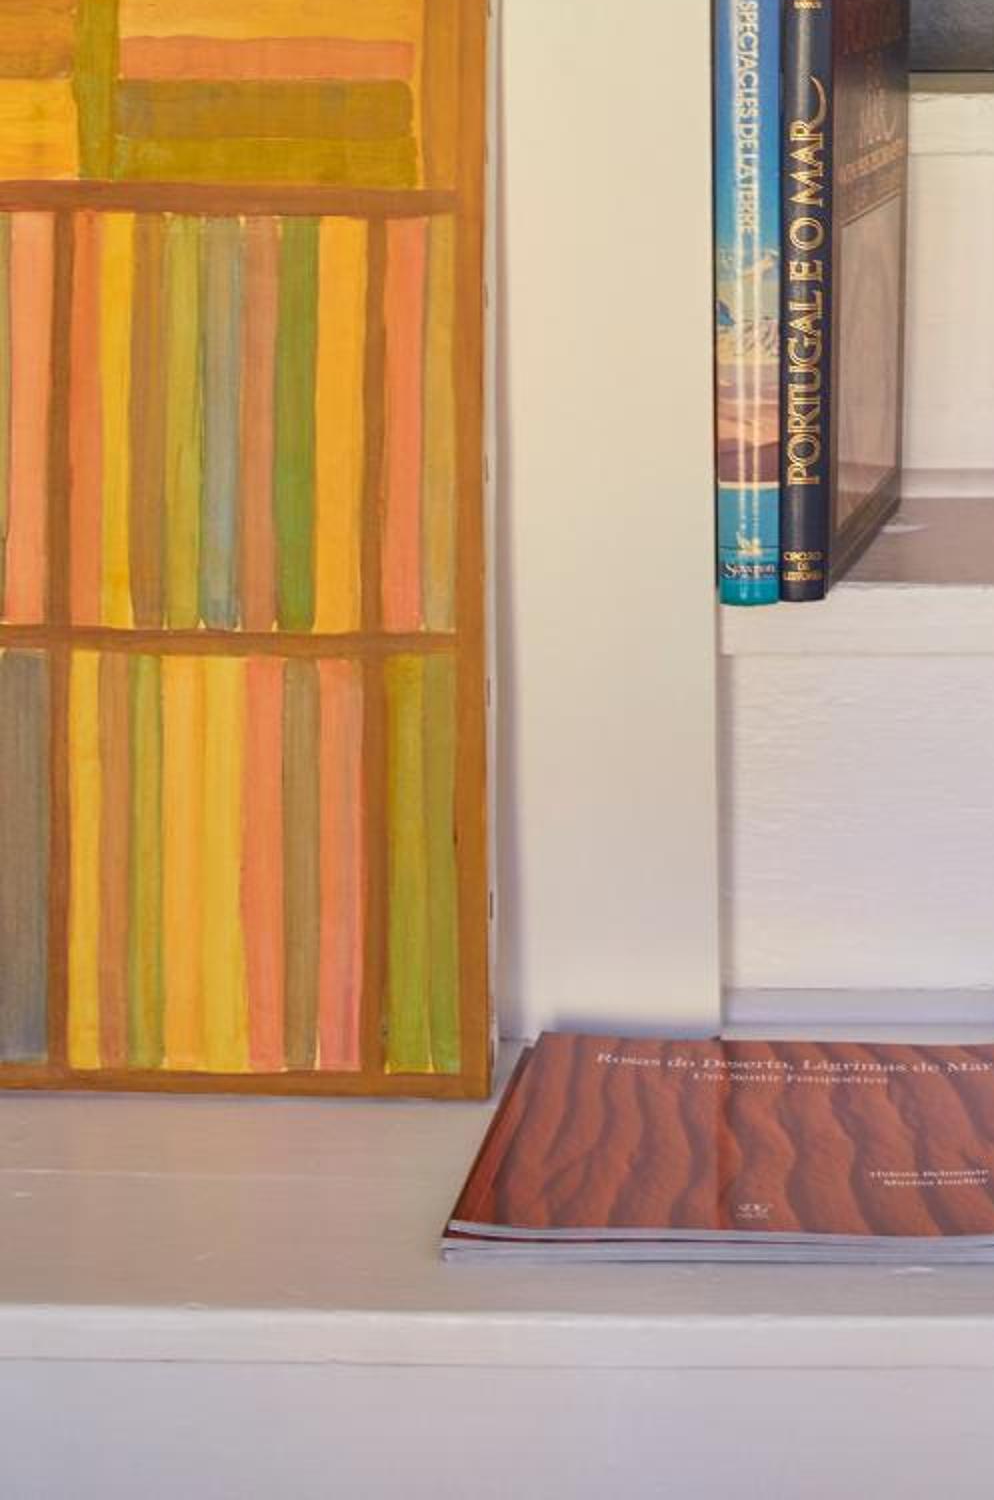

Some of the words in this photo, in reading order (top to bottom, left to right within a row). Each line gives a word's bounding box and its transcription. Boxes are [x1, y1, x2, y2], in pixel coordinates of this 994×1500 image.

[737, 2, 758, 116] SPECTACLES
[737, 121, 758, 147] DE
[789, 76, 826, 206] MAR
[788, 217, 823, 250] O
[788, 259, 821, 282] E
[786, 291, 822, 486] PORTUGAL
